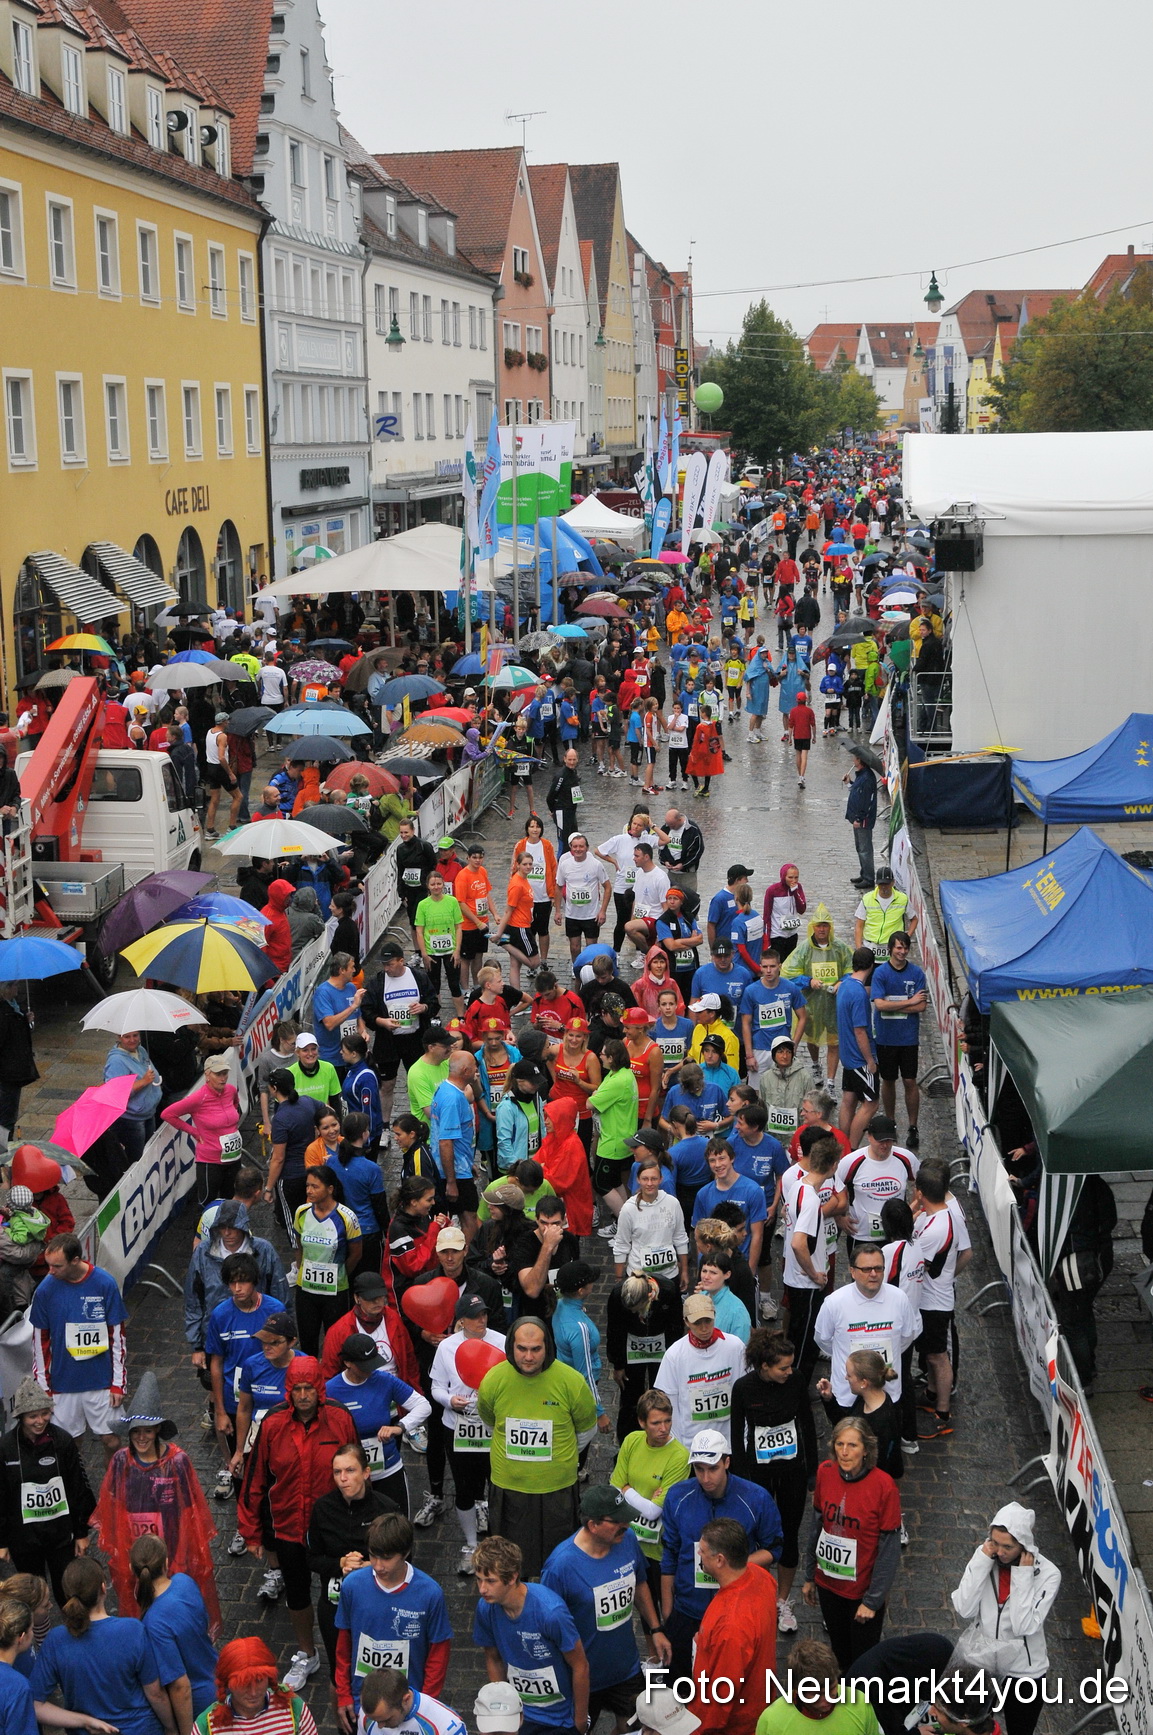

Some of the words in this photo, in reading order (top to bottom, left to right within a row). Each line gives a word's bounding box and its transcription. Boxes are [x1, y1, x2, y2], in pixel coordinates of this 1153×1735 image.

[676, 350, 689, 417] HOTEL
[165, 487, 189, 517] CAFE
[191, 485, 210, 513] DELI
[571, 891, 591, 900] 5106
[782, 919, 802, 929] 5133
[432, 939, 453, 950] 5129
[814, 968, 836, 978] 5028
[760, 1007, 784, 1020] 5219
[659, 1044, 683, 1054] 5208
[770, 1113, 795, 1126] 5085
[121, 1122, 195, 1259] BOCK
[861, 1181, 894, 1189] GERHART
[302, 1235, 332, 1246] BOCK
[644, 1249, 674, 1267] 5076
[304, 1269, 335, 1285] 5118
[73, 1331, 101, 1347] 104
[630, 1340, 663, 1353] 5212
[76, 1347, 99, 1356] Thomas
[694, 1392, 729, 1412] 5179
[510, 1429, 549, 1446] 5074
[757, 1430, 794, 1450] 2893
[520, 1447, 537, 1456] Ivica
[26, 1487, 62, 1509] 5030
[817, 1540, 852, 1567] 5007
[600, 1586, 634, 1615] 5163
[361, 1646, 405, 1669] 5024
[512, 1676, 555, 1696] 5218
